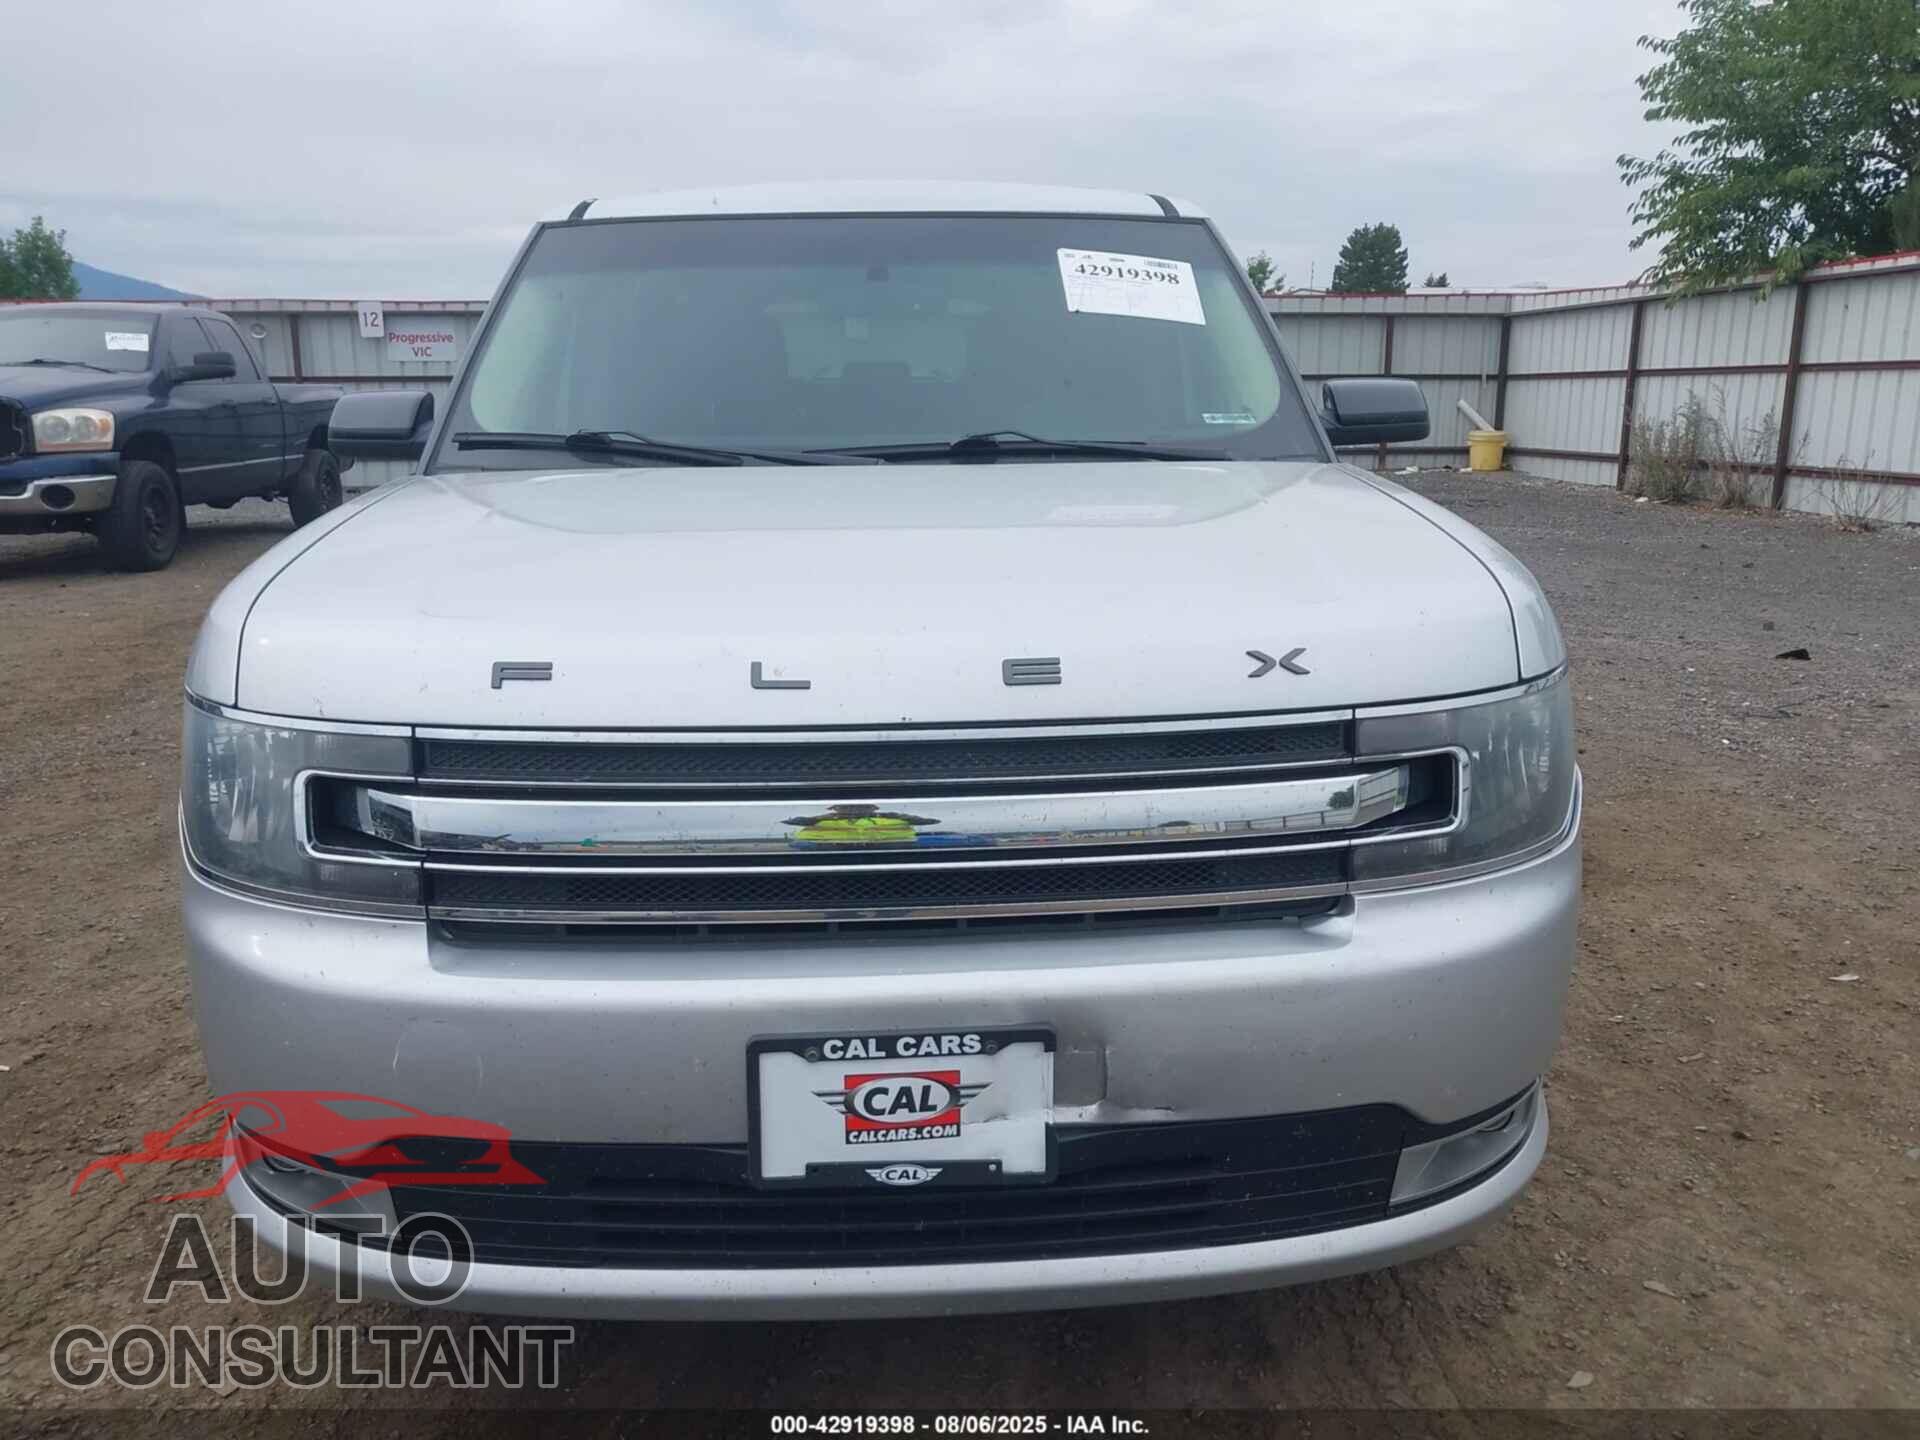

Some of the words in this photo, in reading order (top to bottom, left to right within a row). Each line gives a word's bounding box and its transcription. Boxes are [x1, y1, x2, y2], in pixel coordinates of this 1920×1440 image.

[1074, 263, 1180, 285] 42919398
[363, 312, 379, 327] 12
[389, 332, 453, 344] Progressive
[412, 346, 432, 357] VIC
[823, 1039, 886, 1060] CAL
[896, 1034, 982, 1056] CARS
[863, 1085, 938, 1116] CAL
[848, 1124, 958, 1143] CALCARS.COM
[884, 1168, 921, 1181] CAL
